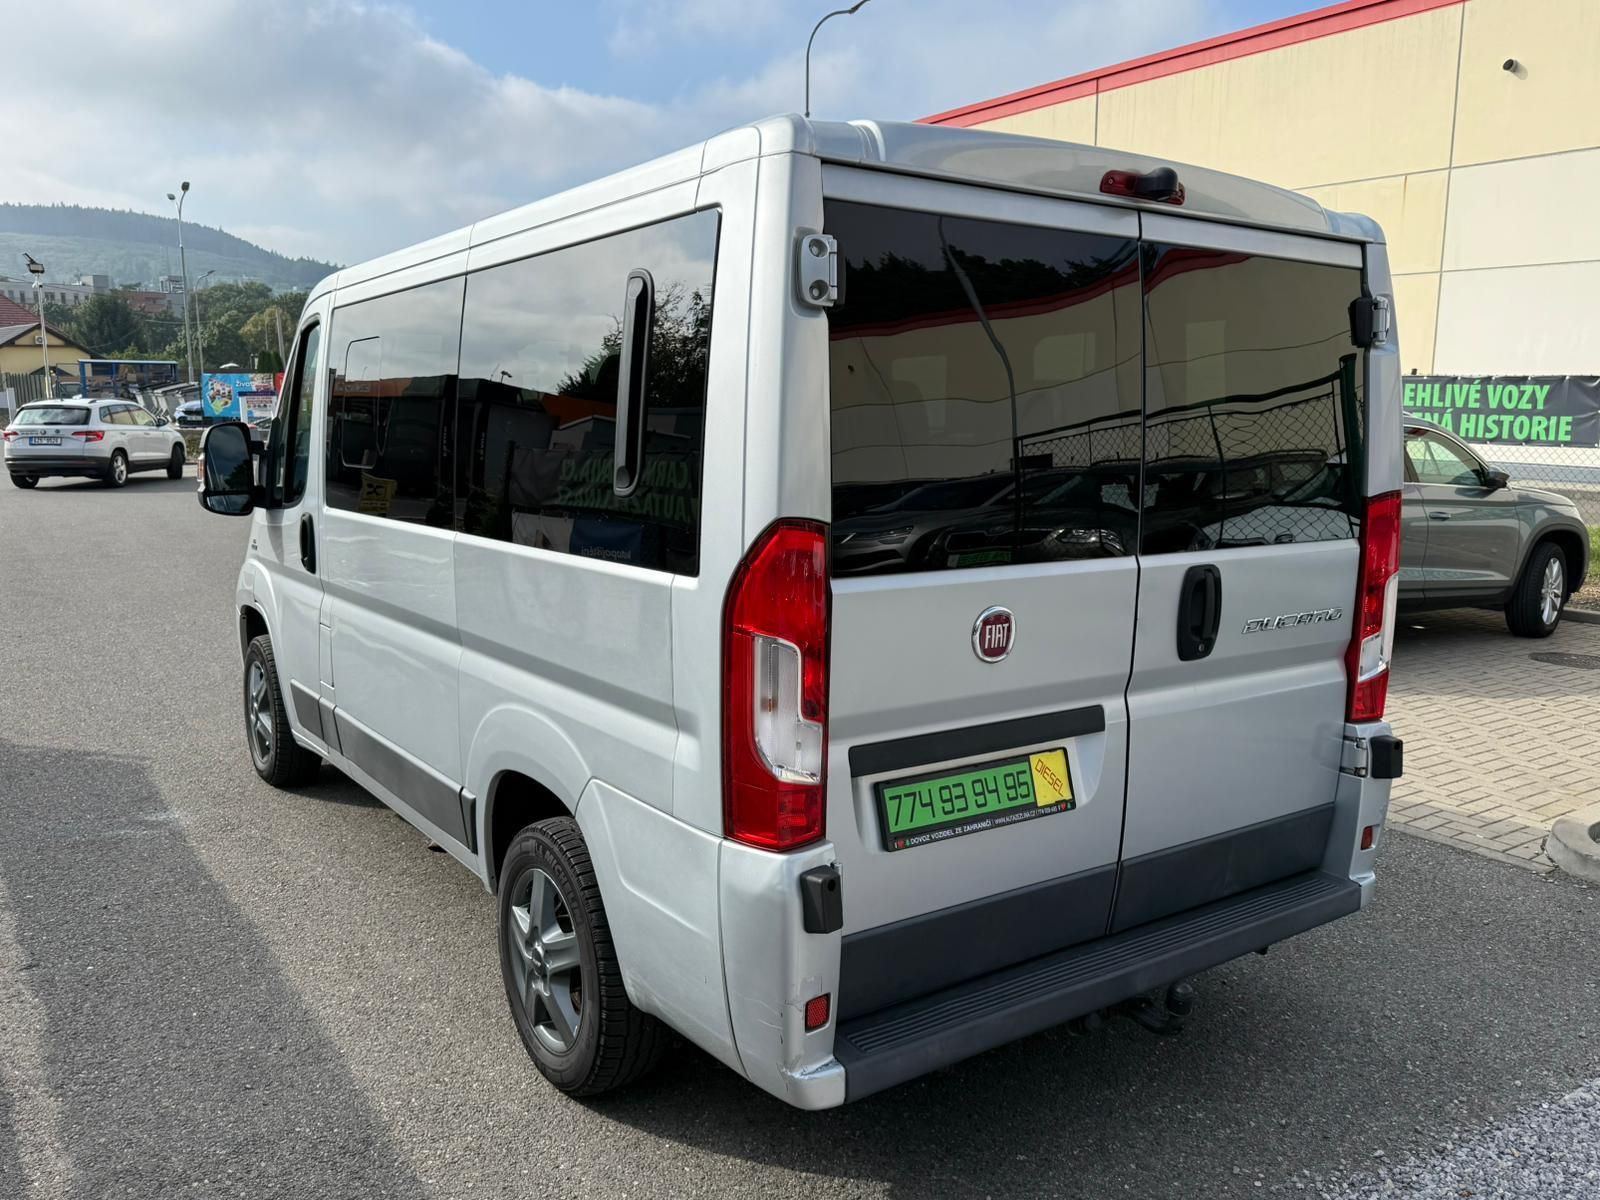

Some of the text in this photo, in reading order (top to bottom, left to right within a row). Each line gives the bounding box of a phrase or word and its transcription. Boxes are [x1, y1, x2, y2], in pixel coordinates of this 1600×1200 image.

[1486, 384, 1551, 410] VOZY
[1459, 413, 1573, 441] HISTORIE
[1241, 606, 1343, 635] DUCATO
[984, 623, 1011, 649] FIAT
[1034, 758, 1064, 797] DIESEL
[888, 769, 1031, 827] 774 93 94 95
[910, 834, 930, 845] DOVOZ
[930, 829, 954, 840] VOZIDEL
[955, 826, 963, 834] ZE
